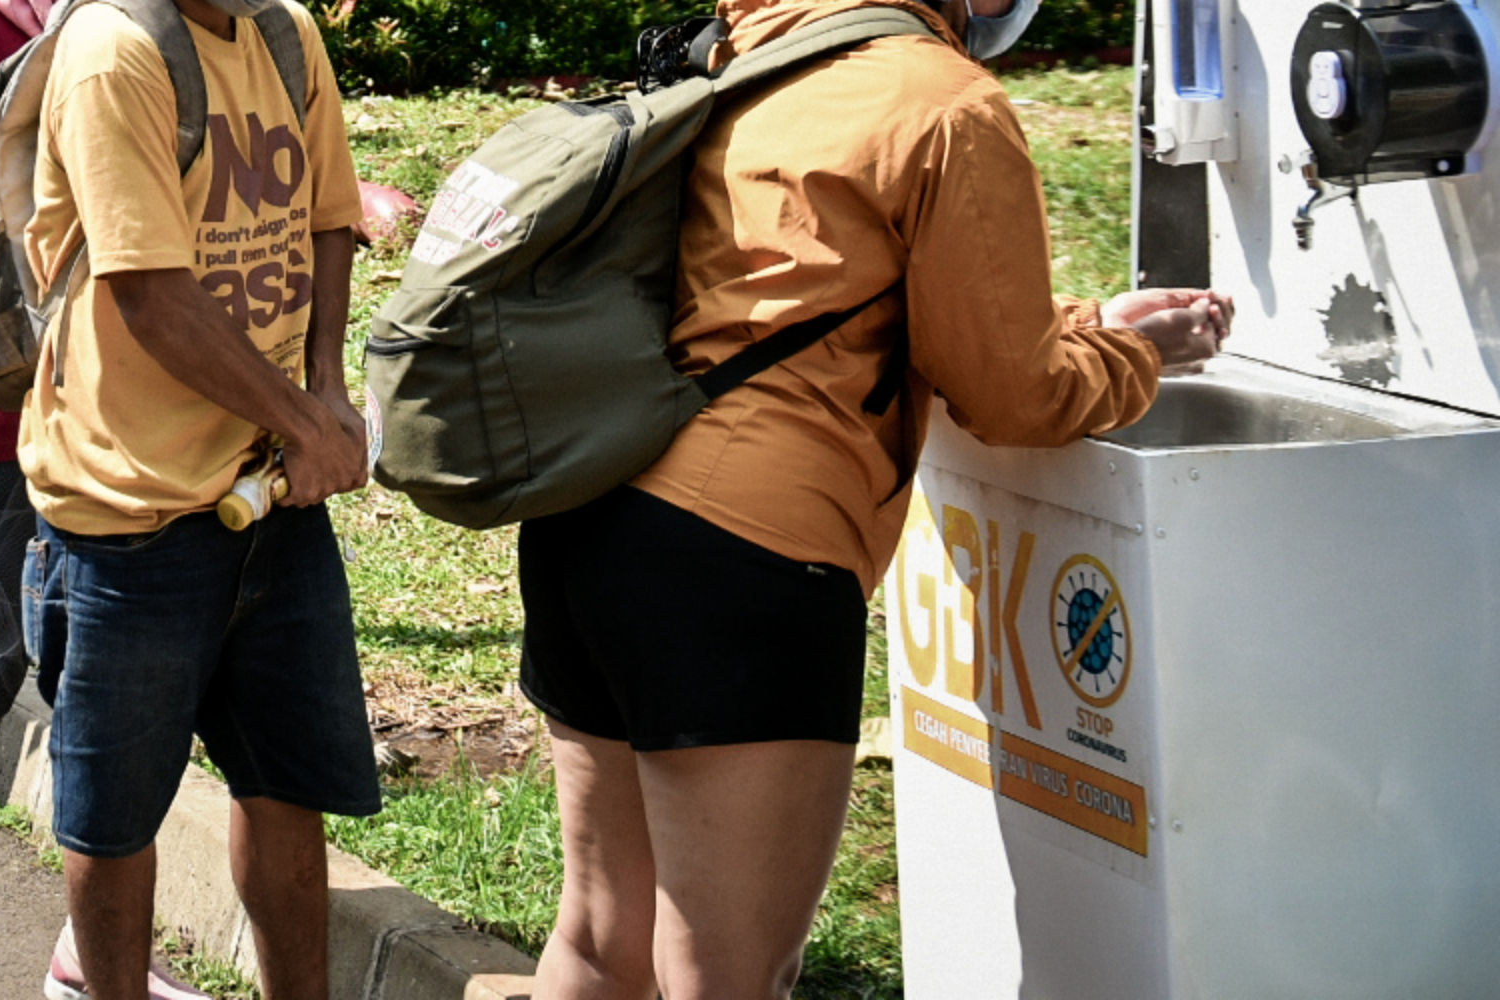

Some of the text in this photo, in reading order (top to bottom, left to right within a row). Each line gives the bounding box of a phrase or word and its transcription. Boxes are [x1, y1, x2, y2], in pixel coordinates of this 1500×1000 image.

[205, 226, 251, 244] don't
[195, 249, 201, 265] I
[205, 249, 237, 268] pull
[896, 490, 1043, 731] GBK
[1075, 706, 1113, 738] STOP
[1066, 727, 1127, 763] CORONAVIRUS
[913, 709, 948, 746] CEGAH
[1031, 763, 1069, 797] VIRUS
[1075, 780, 1133, 825] CORONA
